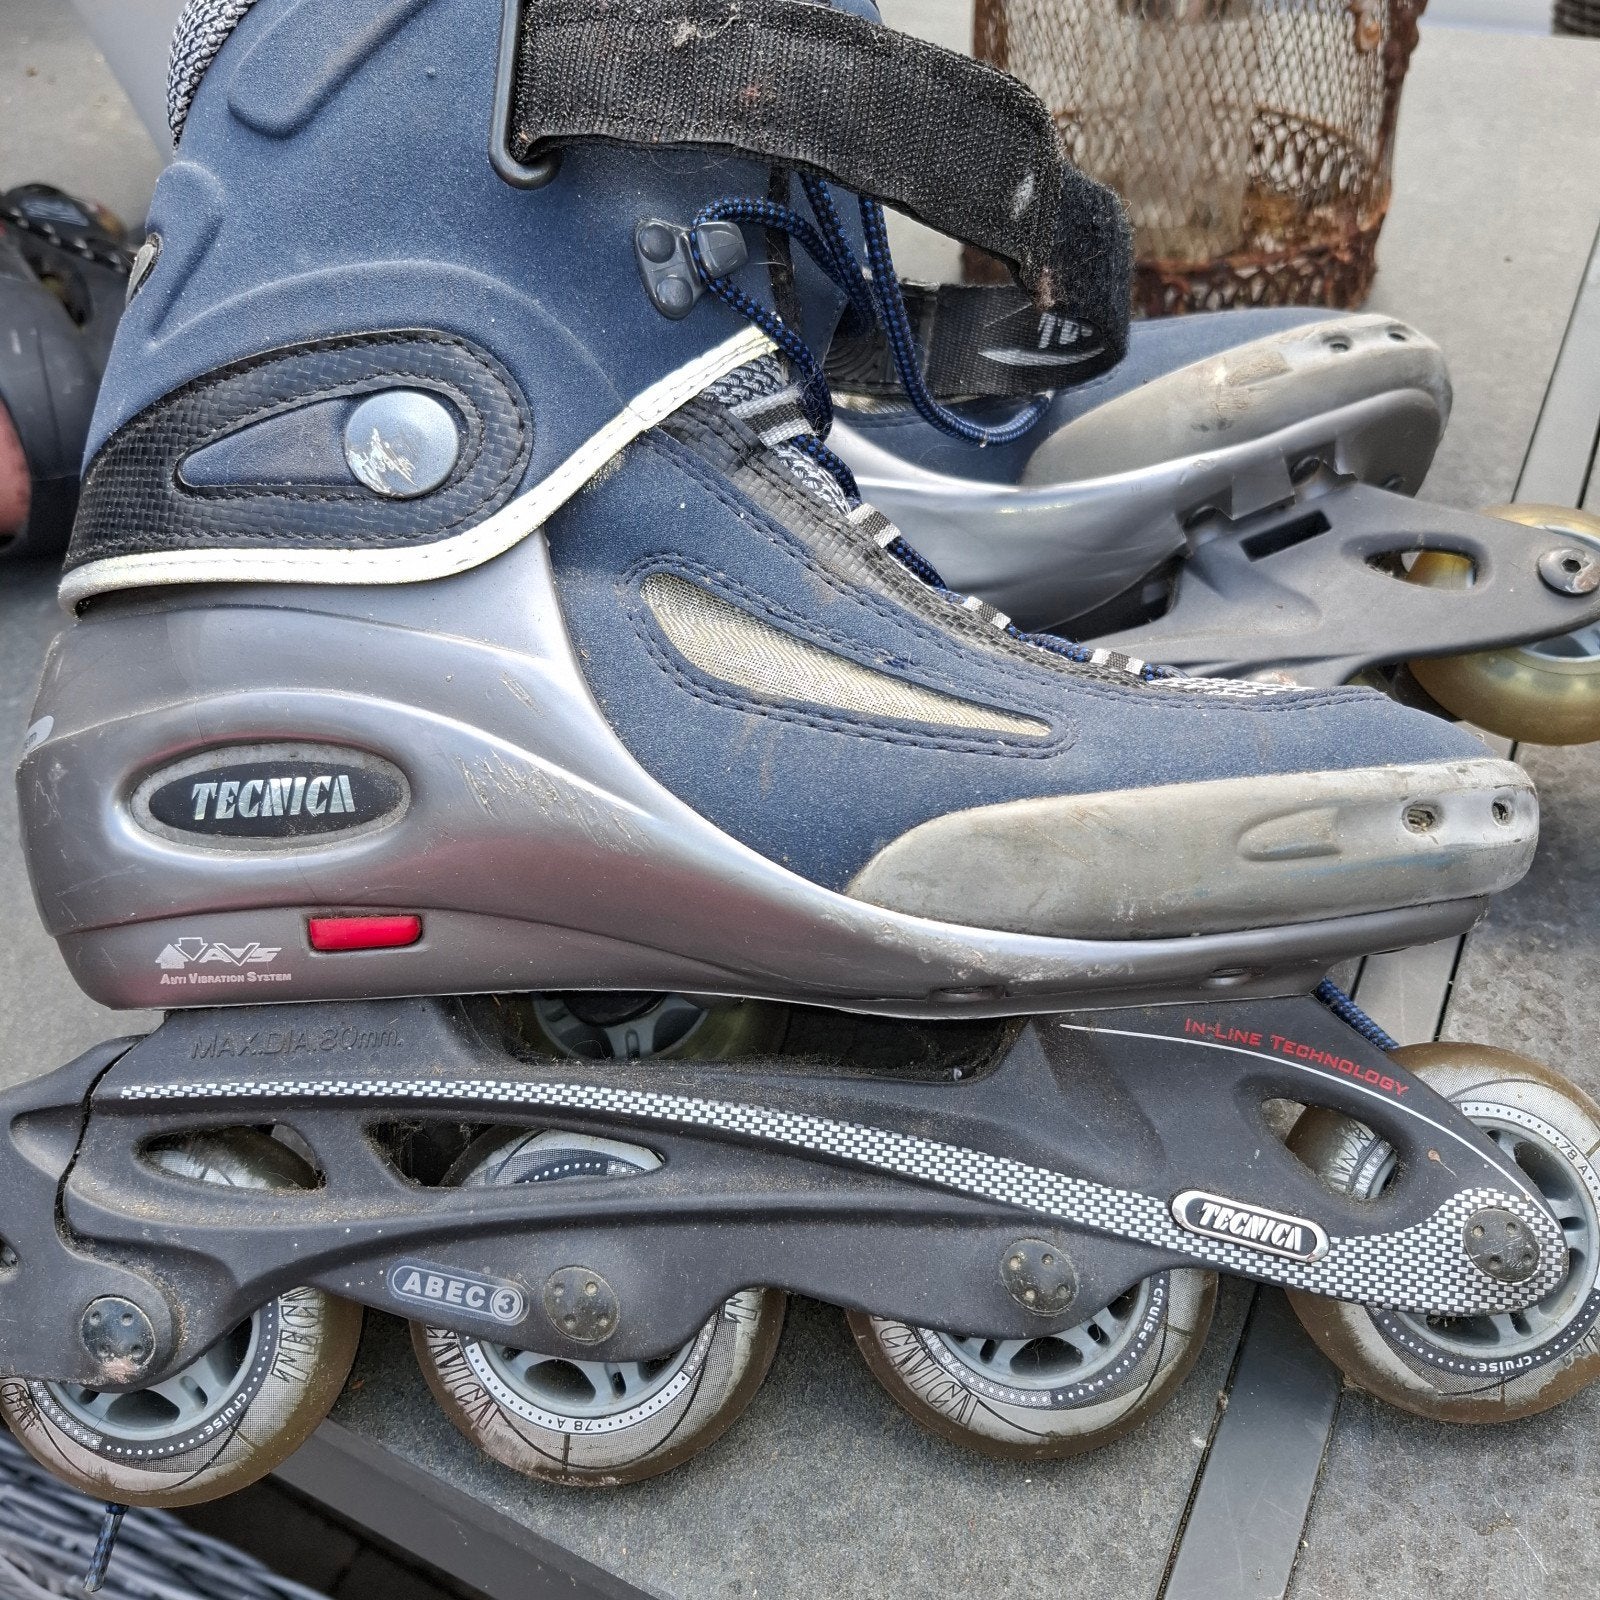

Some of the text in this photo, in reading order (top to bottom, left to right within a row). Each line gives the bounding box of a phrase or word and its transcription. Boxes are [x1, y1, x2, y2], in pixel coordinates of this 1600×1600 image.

[191, 775, 356, 820] TECNICA
[199, 942, 282, 967] AVS
[1559, 1140, 1578, 1160] 78
[1199, 1202, 1302, 1251] TECNICA
[402, 1271, 486, 1308] ABEC
[1138, 1287, 1164, 1342] cruise
[1479, 1355, 1533, 1375] cruise
[203, 1392, 247, 1436] cruise
[557, 1417, 594, 1432] 78 A
